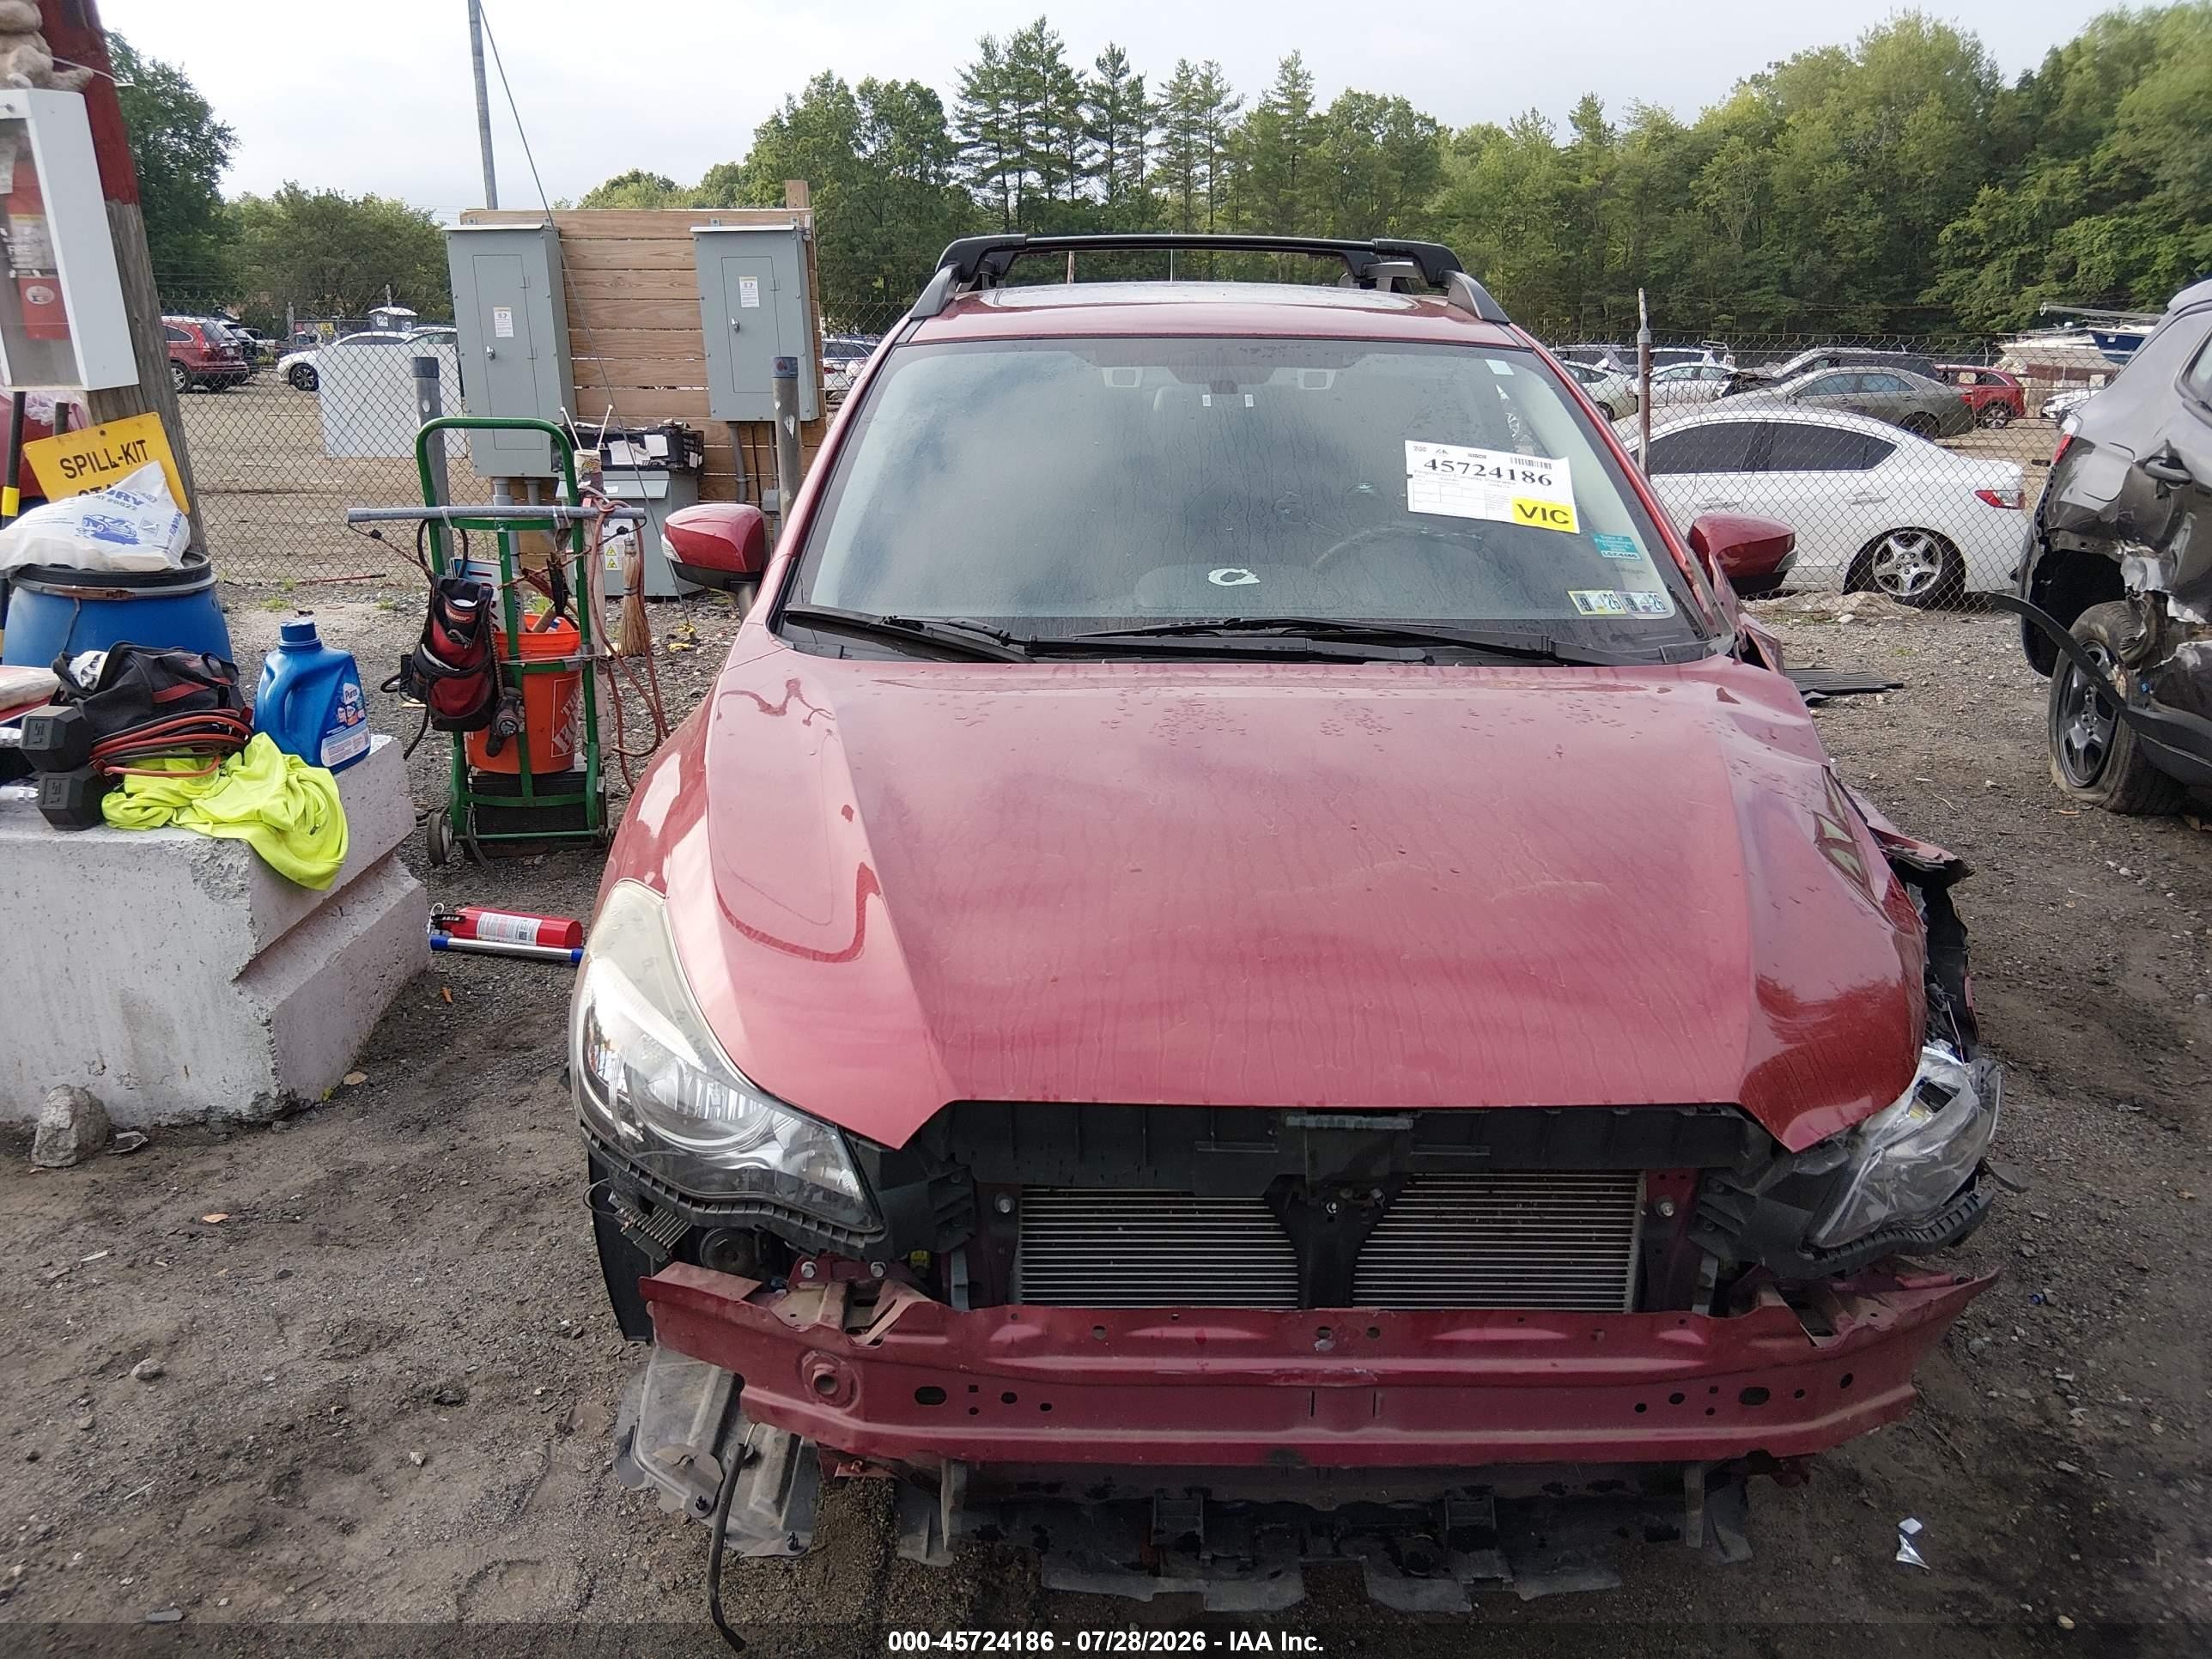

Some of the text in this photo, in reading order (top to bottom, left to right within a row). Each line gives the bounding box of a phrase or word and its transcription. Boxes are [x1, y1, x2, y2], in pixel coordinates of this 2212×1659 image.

[59, 439, 149, 479] SPILL-KIT
[1424, 458, 1553, 487] 45724186
[1516, 503, 1570, 524] VIC
[1602, 593, 1621, 611] 26
